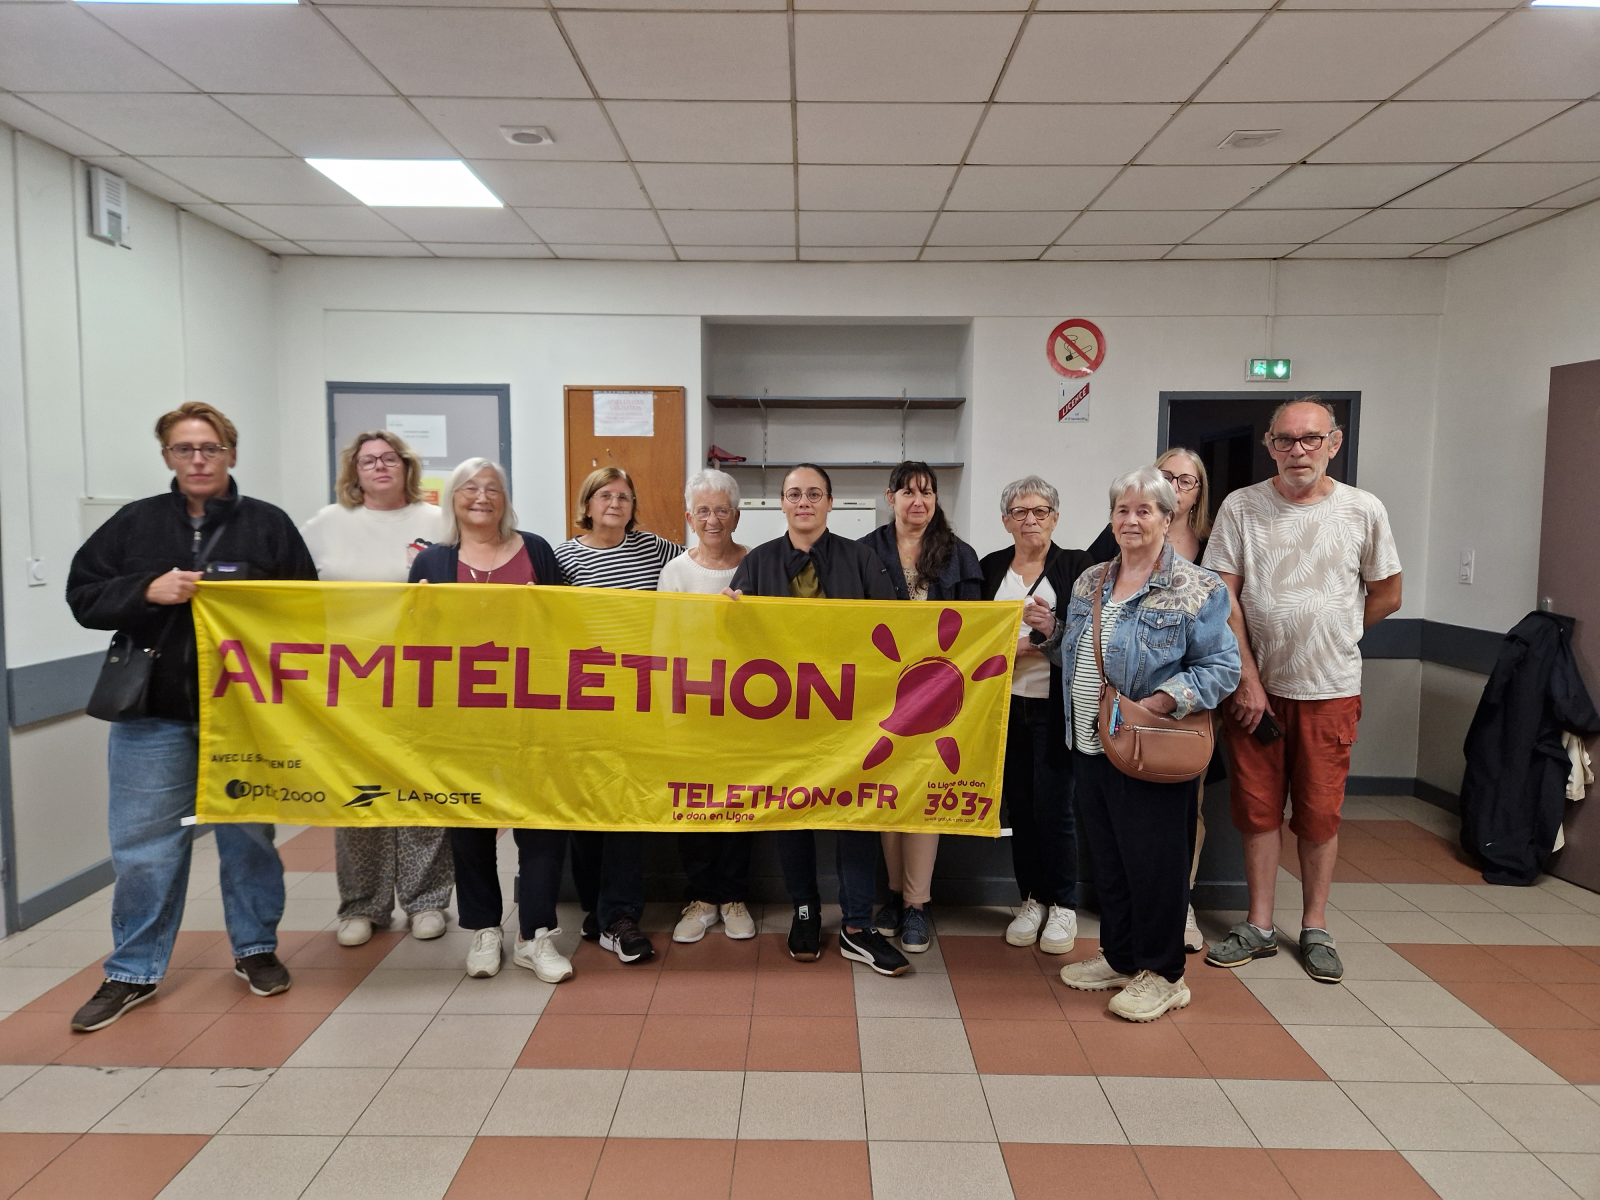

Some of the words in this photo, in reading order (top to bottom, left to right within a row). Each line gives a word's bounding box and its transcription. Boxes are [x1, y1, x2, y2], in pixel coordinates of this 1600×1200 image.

[1062, 387, 1087, 416] LICENCE
[211, 753, 239, 762] AVEC
[241, 753, 253, 762] LE
[287, 759, 302, 769] DE
[957, 779, 968, 787] du
[969, 780, 986, 788] don
[397, 789, 421, 802] LA
[423, 792, 482, 805] POSTE
[686, 811, 707, 821] don
[709, 812, 723, 820] en
